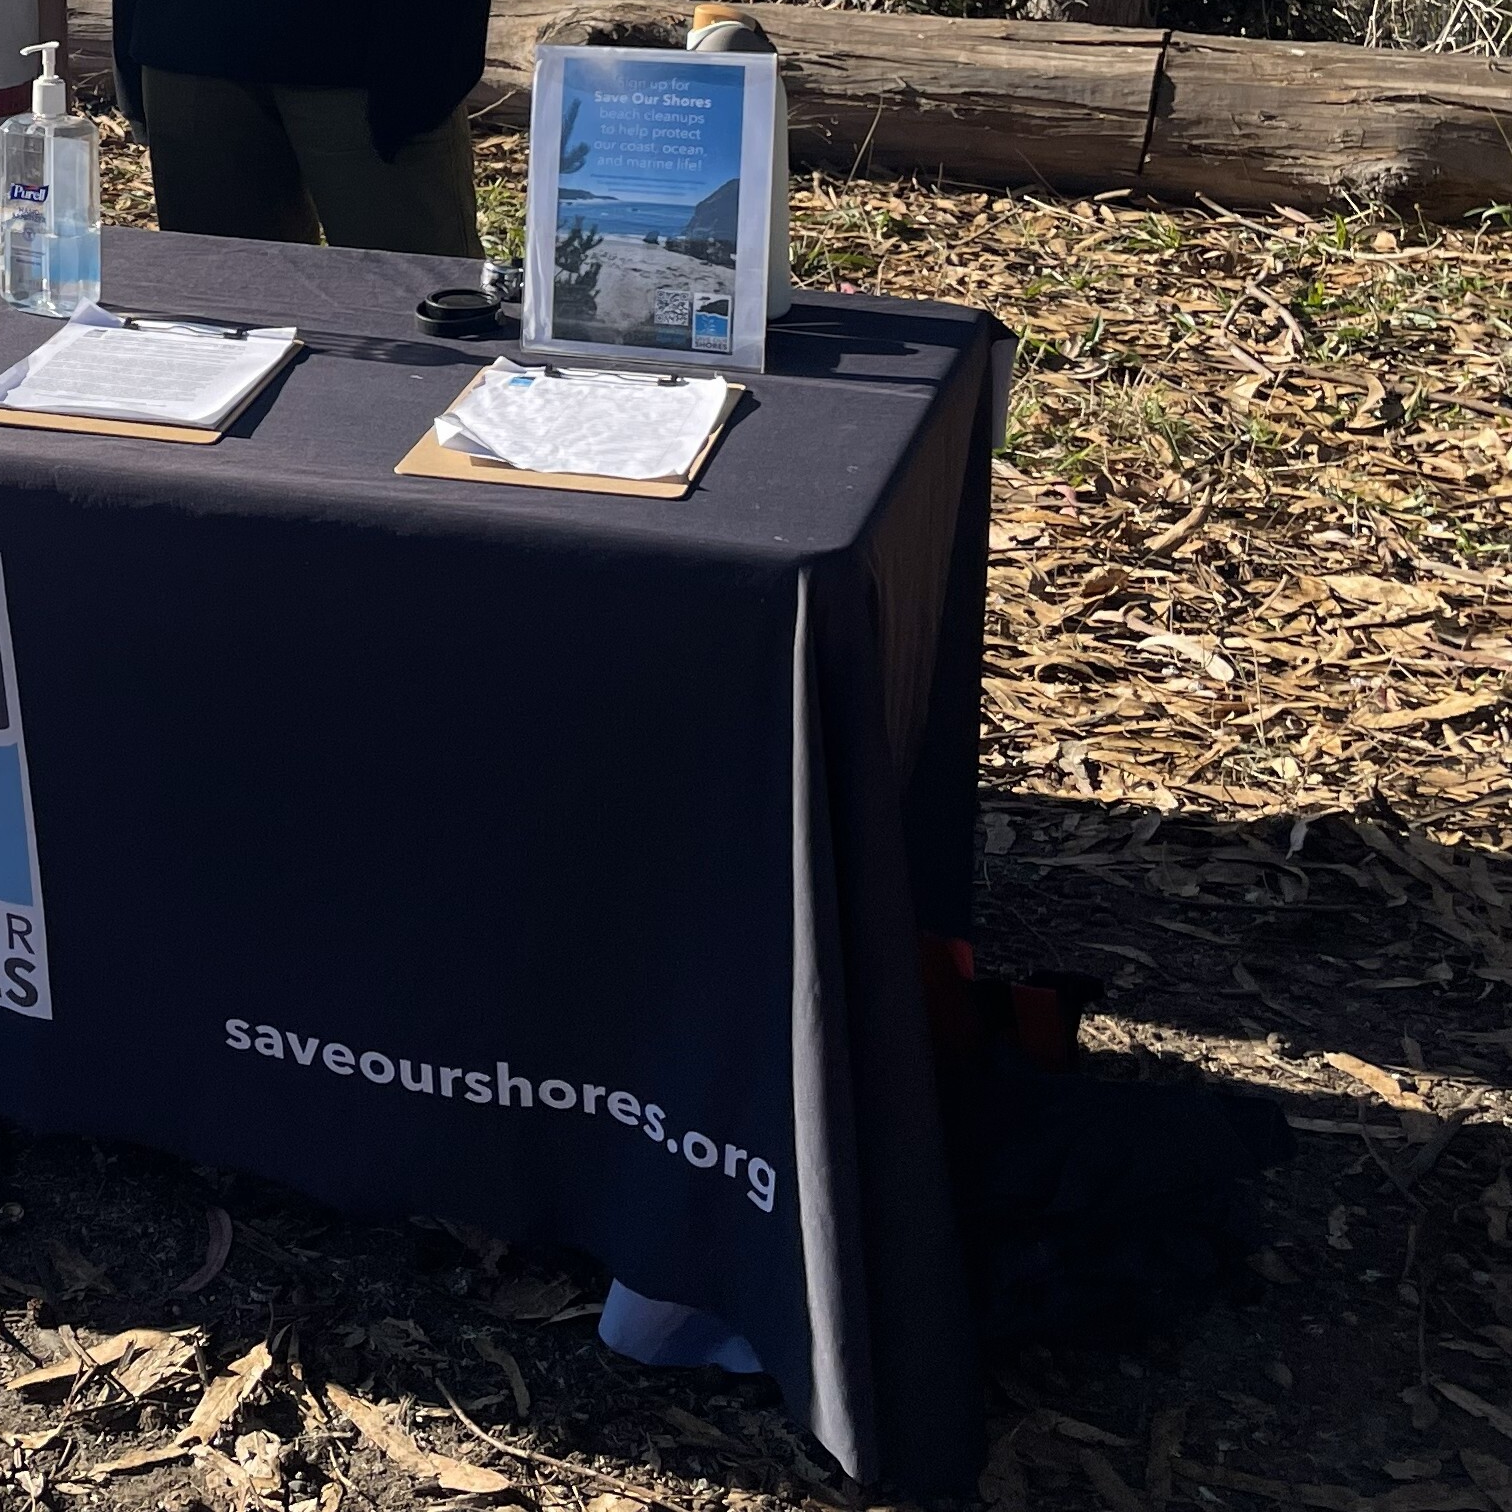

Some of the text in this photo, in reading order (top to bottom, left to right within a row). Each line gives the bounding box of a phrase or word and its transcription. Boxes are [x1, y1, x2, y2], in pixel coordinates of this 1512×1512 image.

[649, 81, 667, 92] up
[669, 77, 691, 91] for
[594, 90, 712, 109] Save Our Shores
[599, 107, 705, 126] beach cleanups
[600, 124, 701, 141] to help protect
[593, 140, 617, 151] our
[662, 144, 708, 157] ocean,
[597, 155, 703, 172] and marine life!
[14, 185, 46, 201] Purell
[695, 341, 728, 350] SHORES
[225, 1018, 776, 1213] saveourshores.org
